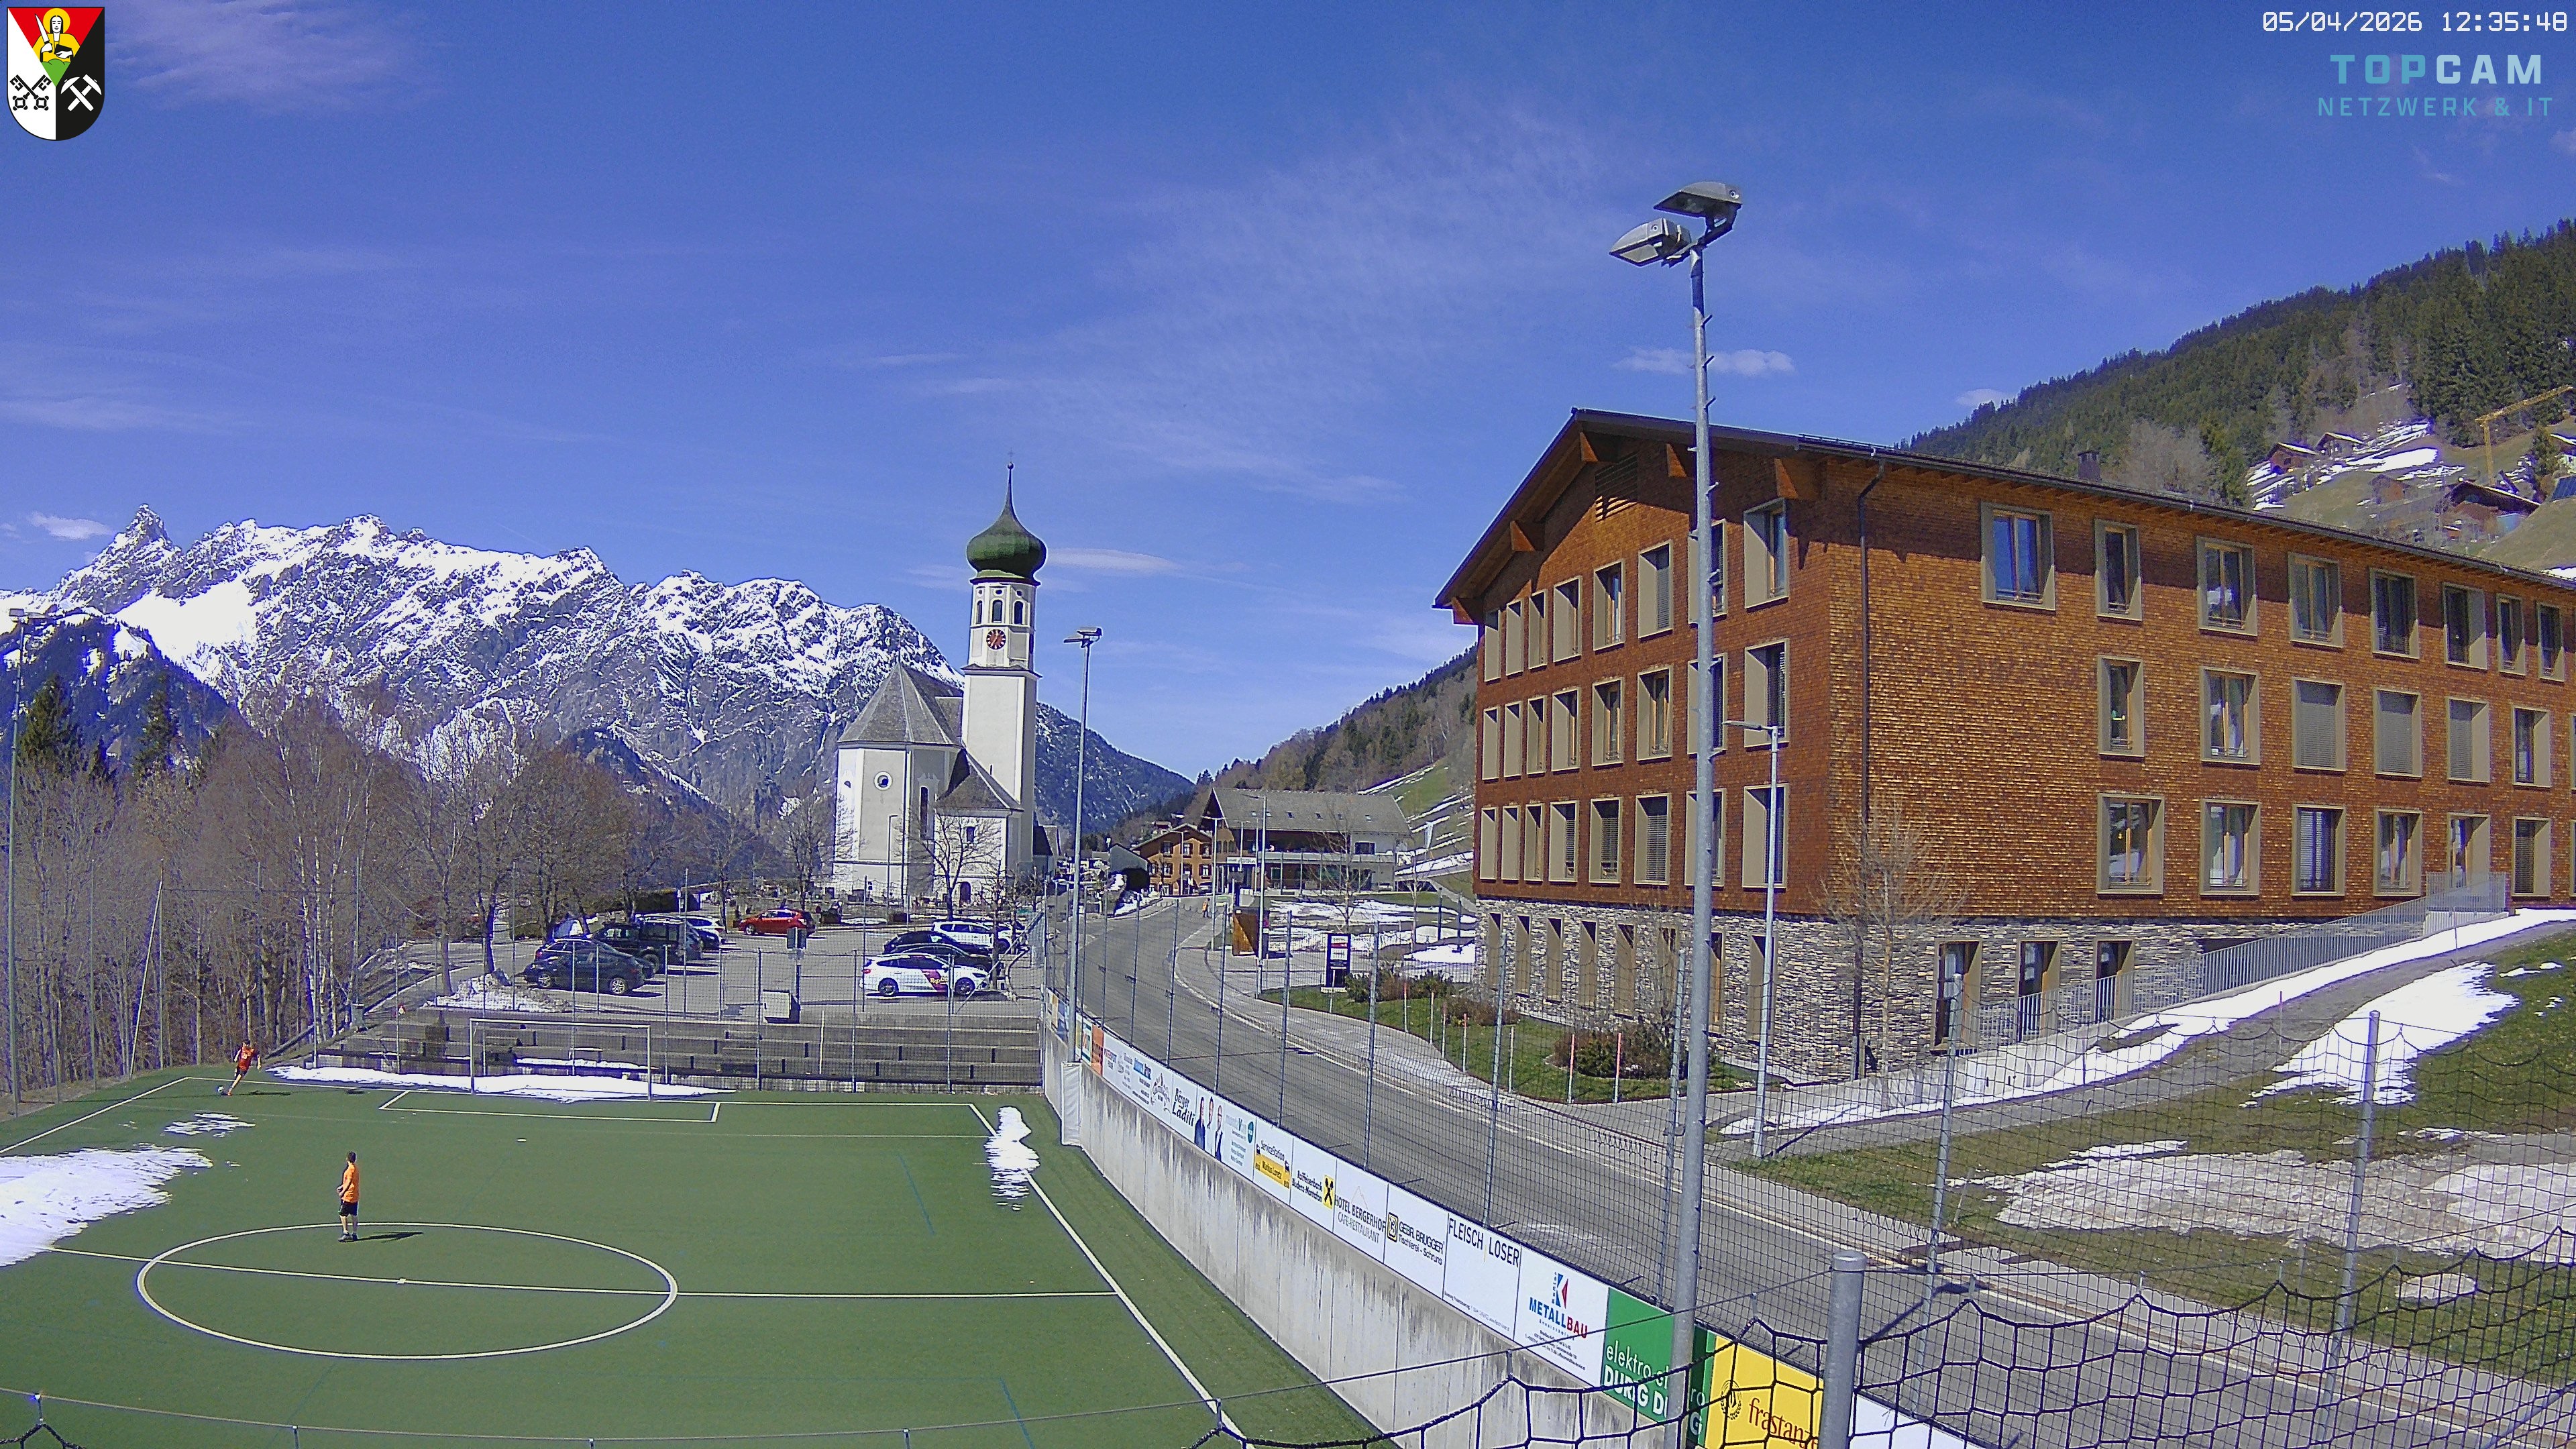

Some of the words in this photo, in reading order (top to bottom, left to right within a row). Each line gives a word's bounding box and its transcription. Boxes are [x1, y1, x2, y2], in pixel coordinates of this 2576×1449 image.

[1334, 1194, 1350, 1214] HOTEL
[1352, 1204, 1386, 1232] BERGERHOF
[1399, 1234, 1419, 1253] Tischlerei
[1423, 1248, 1442, 1265] Schruns
[1416, 1230, 1444, 1254] BRUGGER
[1449, 1218, 1484, 1250] FLEISCH
[1489, 1236, 1519, 1268] LOSER
[1529, 1297, 1588, 1339] METALLBAU
[1607, 1340, 1652, 1380] elektro
